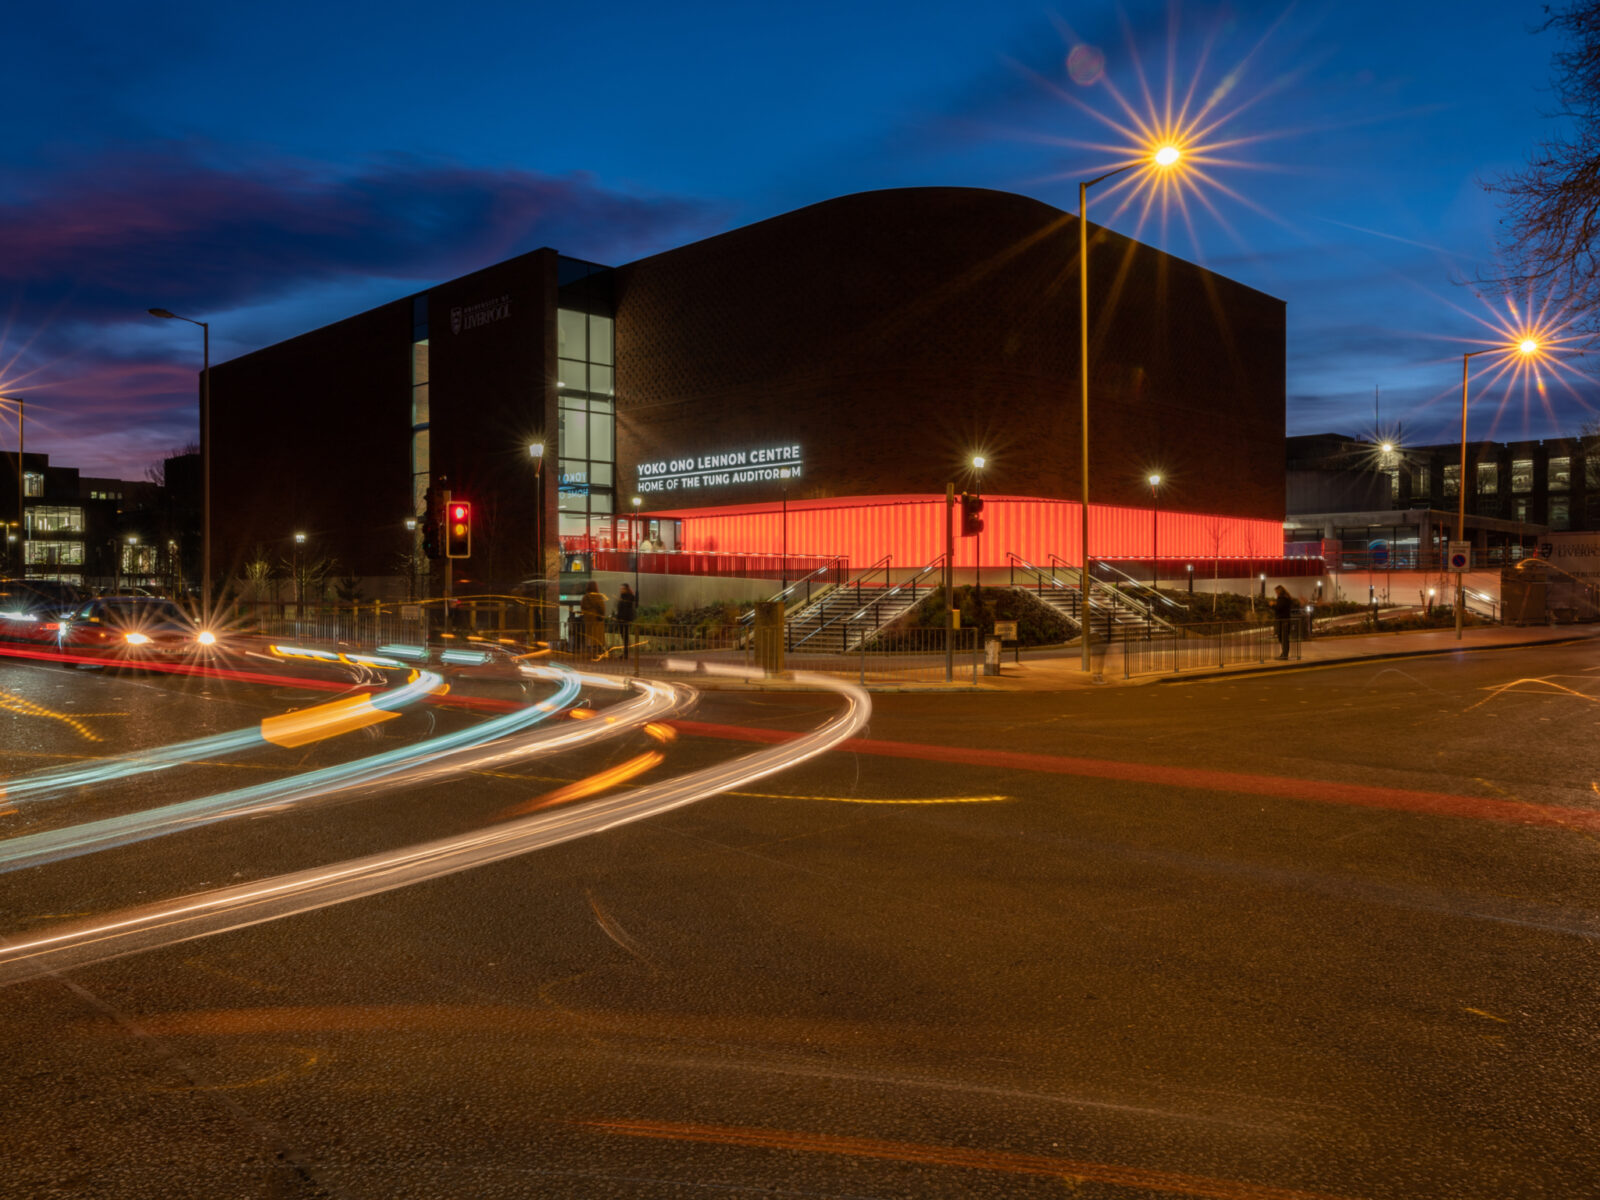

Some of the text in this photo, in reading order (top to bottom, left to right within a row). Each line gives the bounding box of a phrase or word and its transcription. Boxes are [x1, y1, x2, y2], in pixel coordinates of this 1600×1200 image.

[638, 445, 800, 476] YOKO ONO LENNON CENTRE
[638, 466, 801, 493] HOME OF THE TUNG AUDITORM
